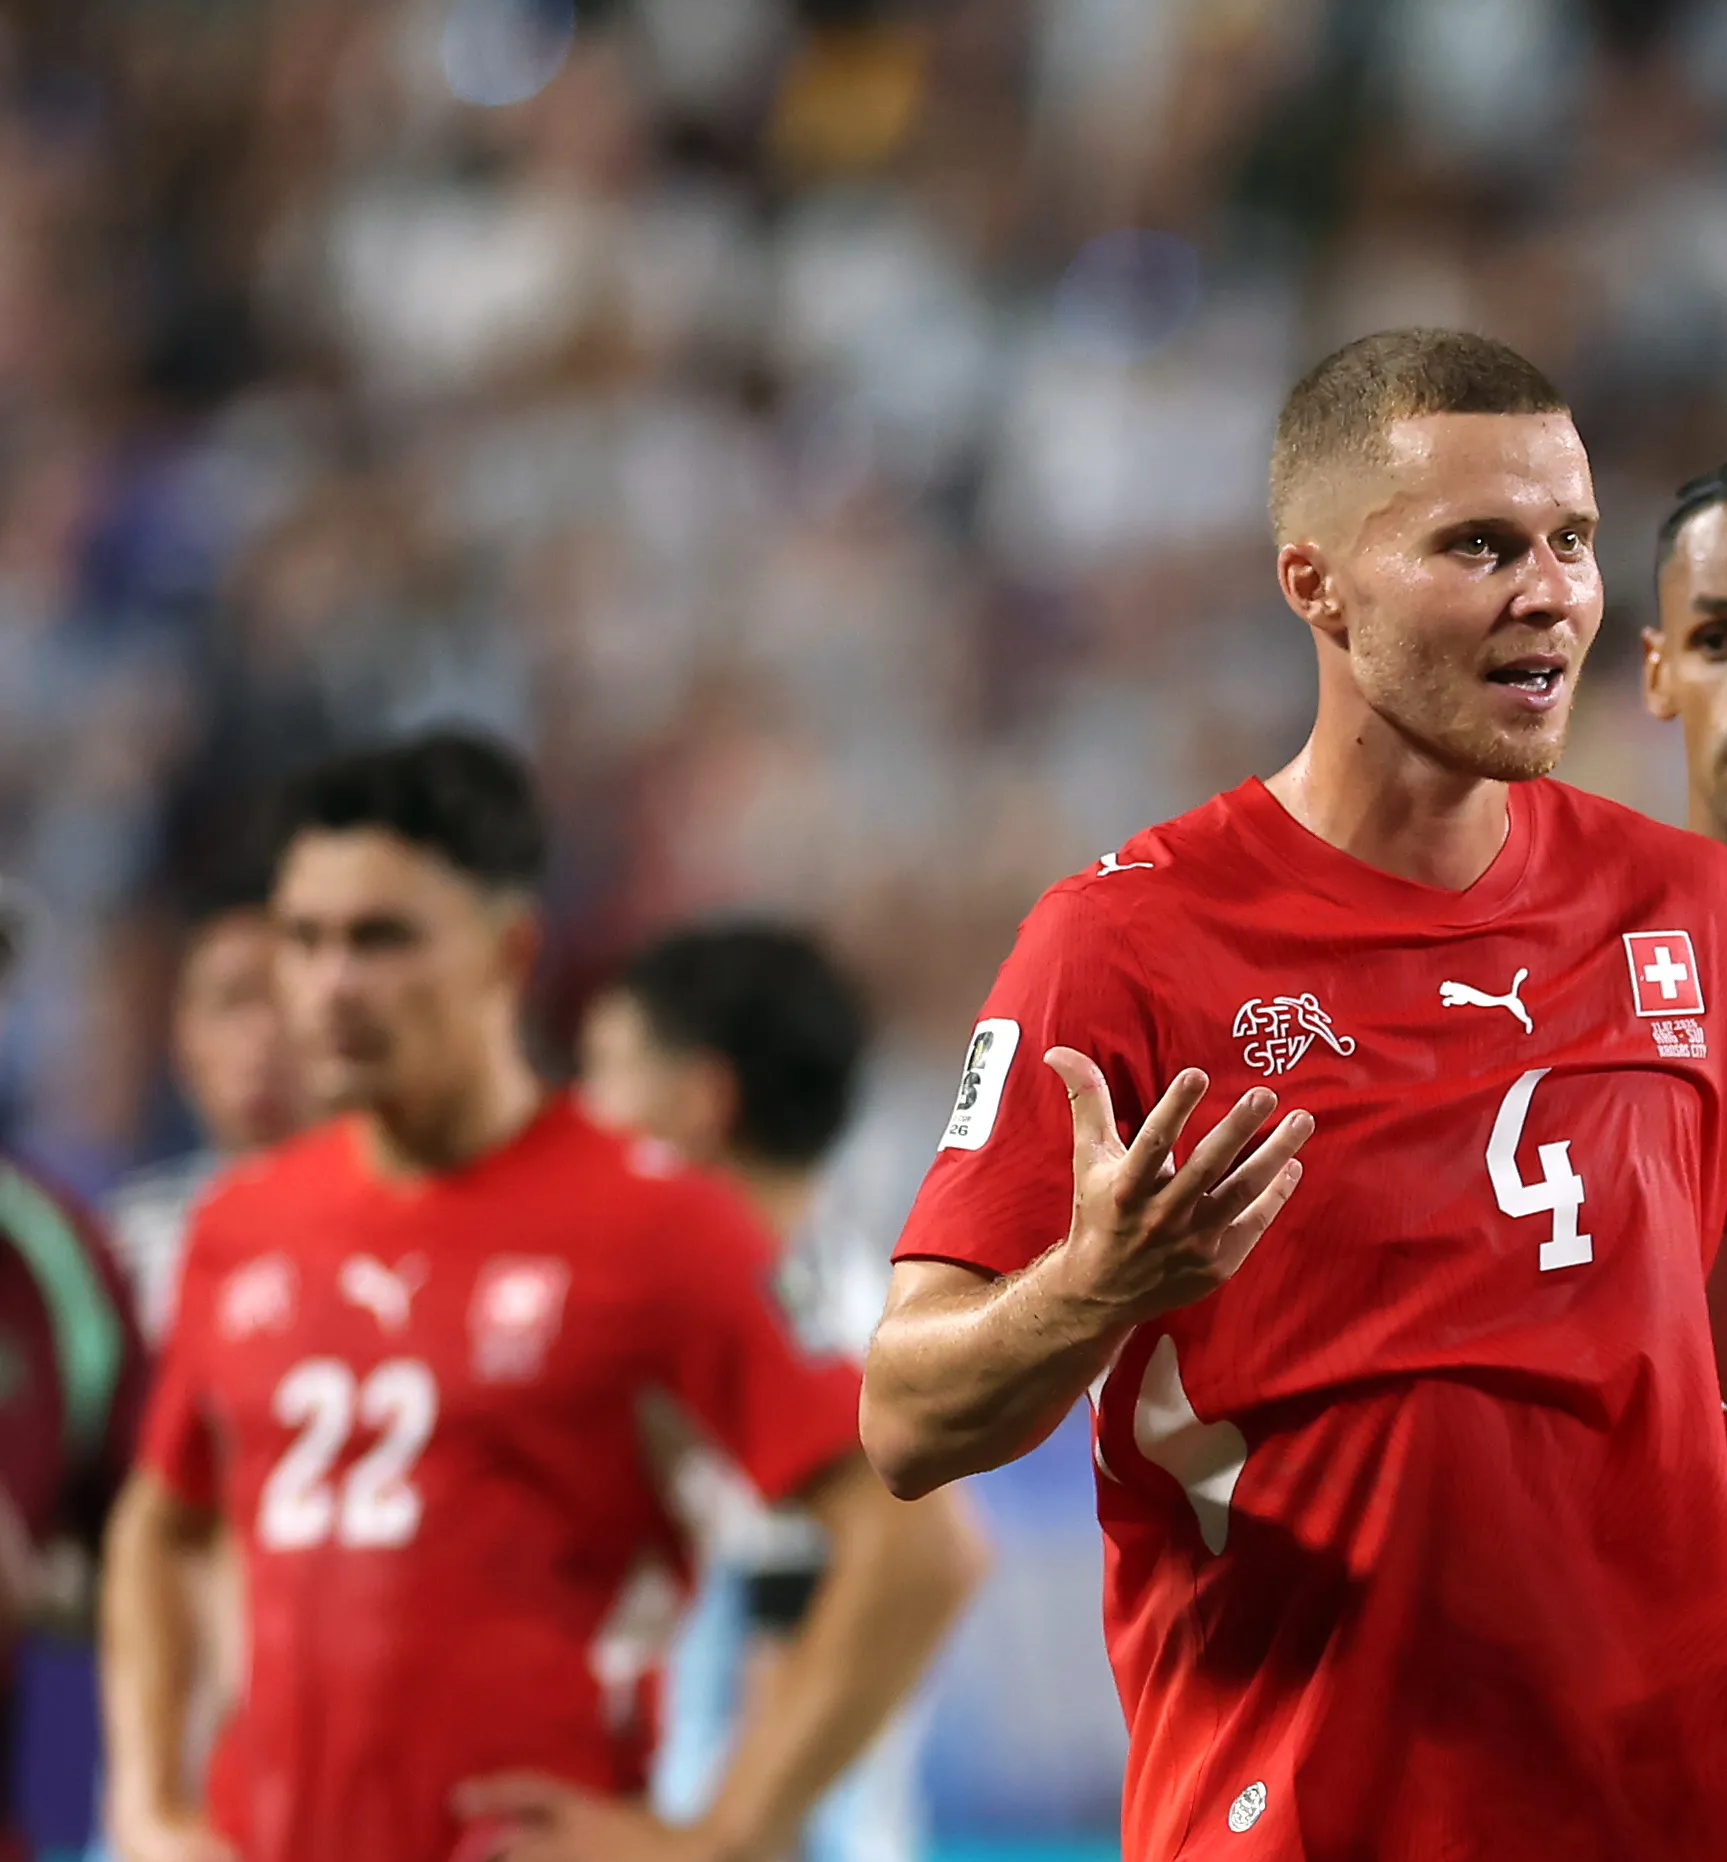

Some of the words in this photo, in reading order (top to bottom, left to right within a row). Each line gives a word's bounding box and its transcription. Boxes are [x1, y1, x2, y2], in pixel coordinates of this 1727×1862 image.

[948, 1124, 969, 1136] 26
[1485, 1067, 1594, 1272] 4
[257, 1359, 439, 1552] 22
